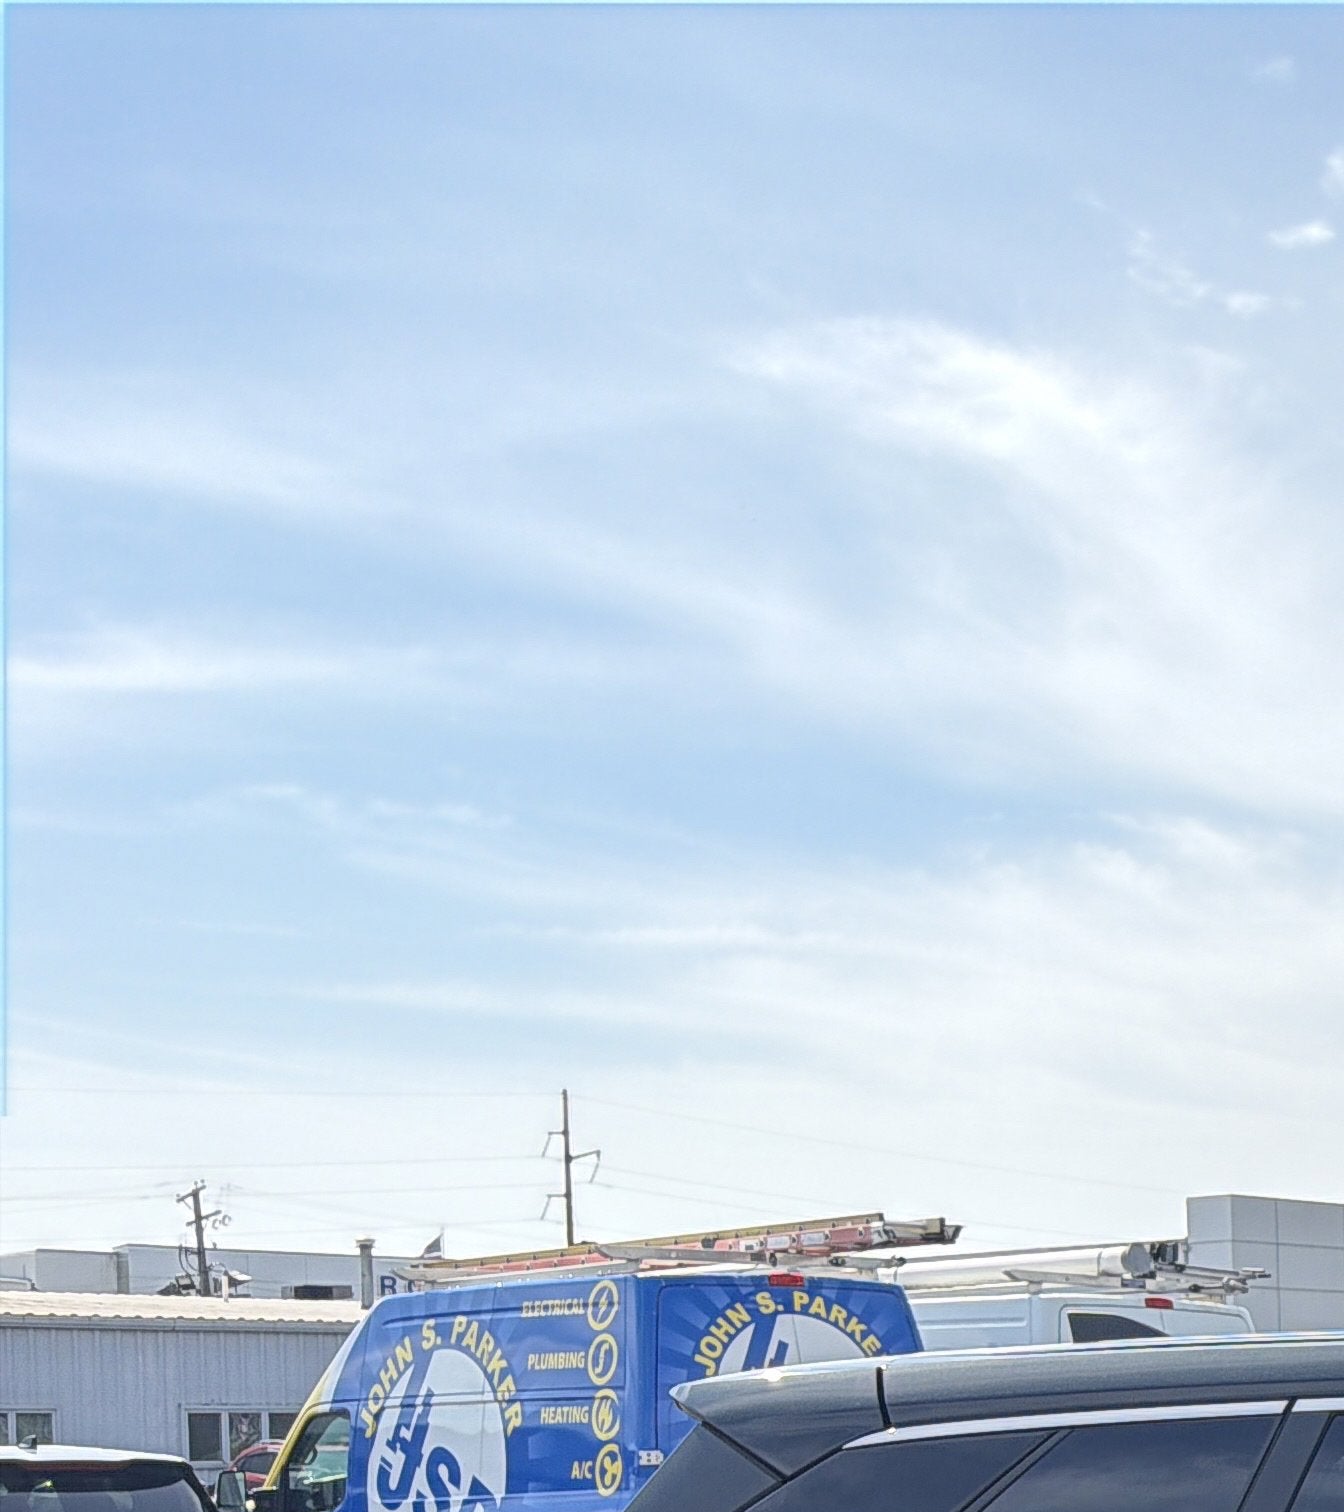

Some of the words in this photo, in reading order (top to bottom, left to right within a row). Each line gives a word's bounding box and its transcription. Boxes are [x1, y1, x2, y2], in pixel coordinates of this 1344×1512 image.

[521, 1297, 585, 1318] ELECTRICAL
[693, 1302, 752, 1376] JOHN
[755, 1291, 785, 1315] S.
[792, 1290, 882, 1357] PARKE
[527, 1351, 585, 1370] PLUMBING
[360, 1336, 414, 1438] JOHN
[421, 1318, 442, 1350] S.
[450, 1315, 522, 1438] PARKER
[540, 1406, 589, 1425] HEATING
[570, 1461, 592, 1479] A/C
